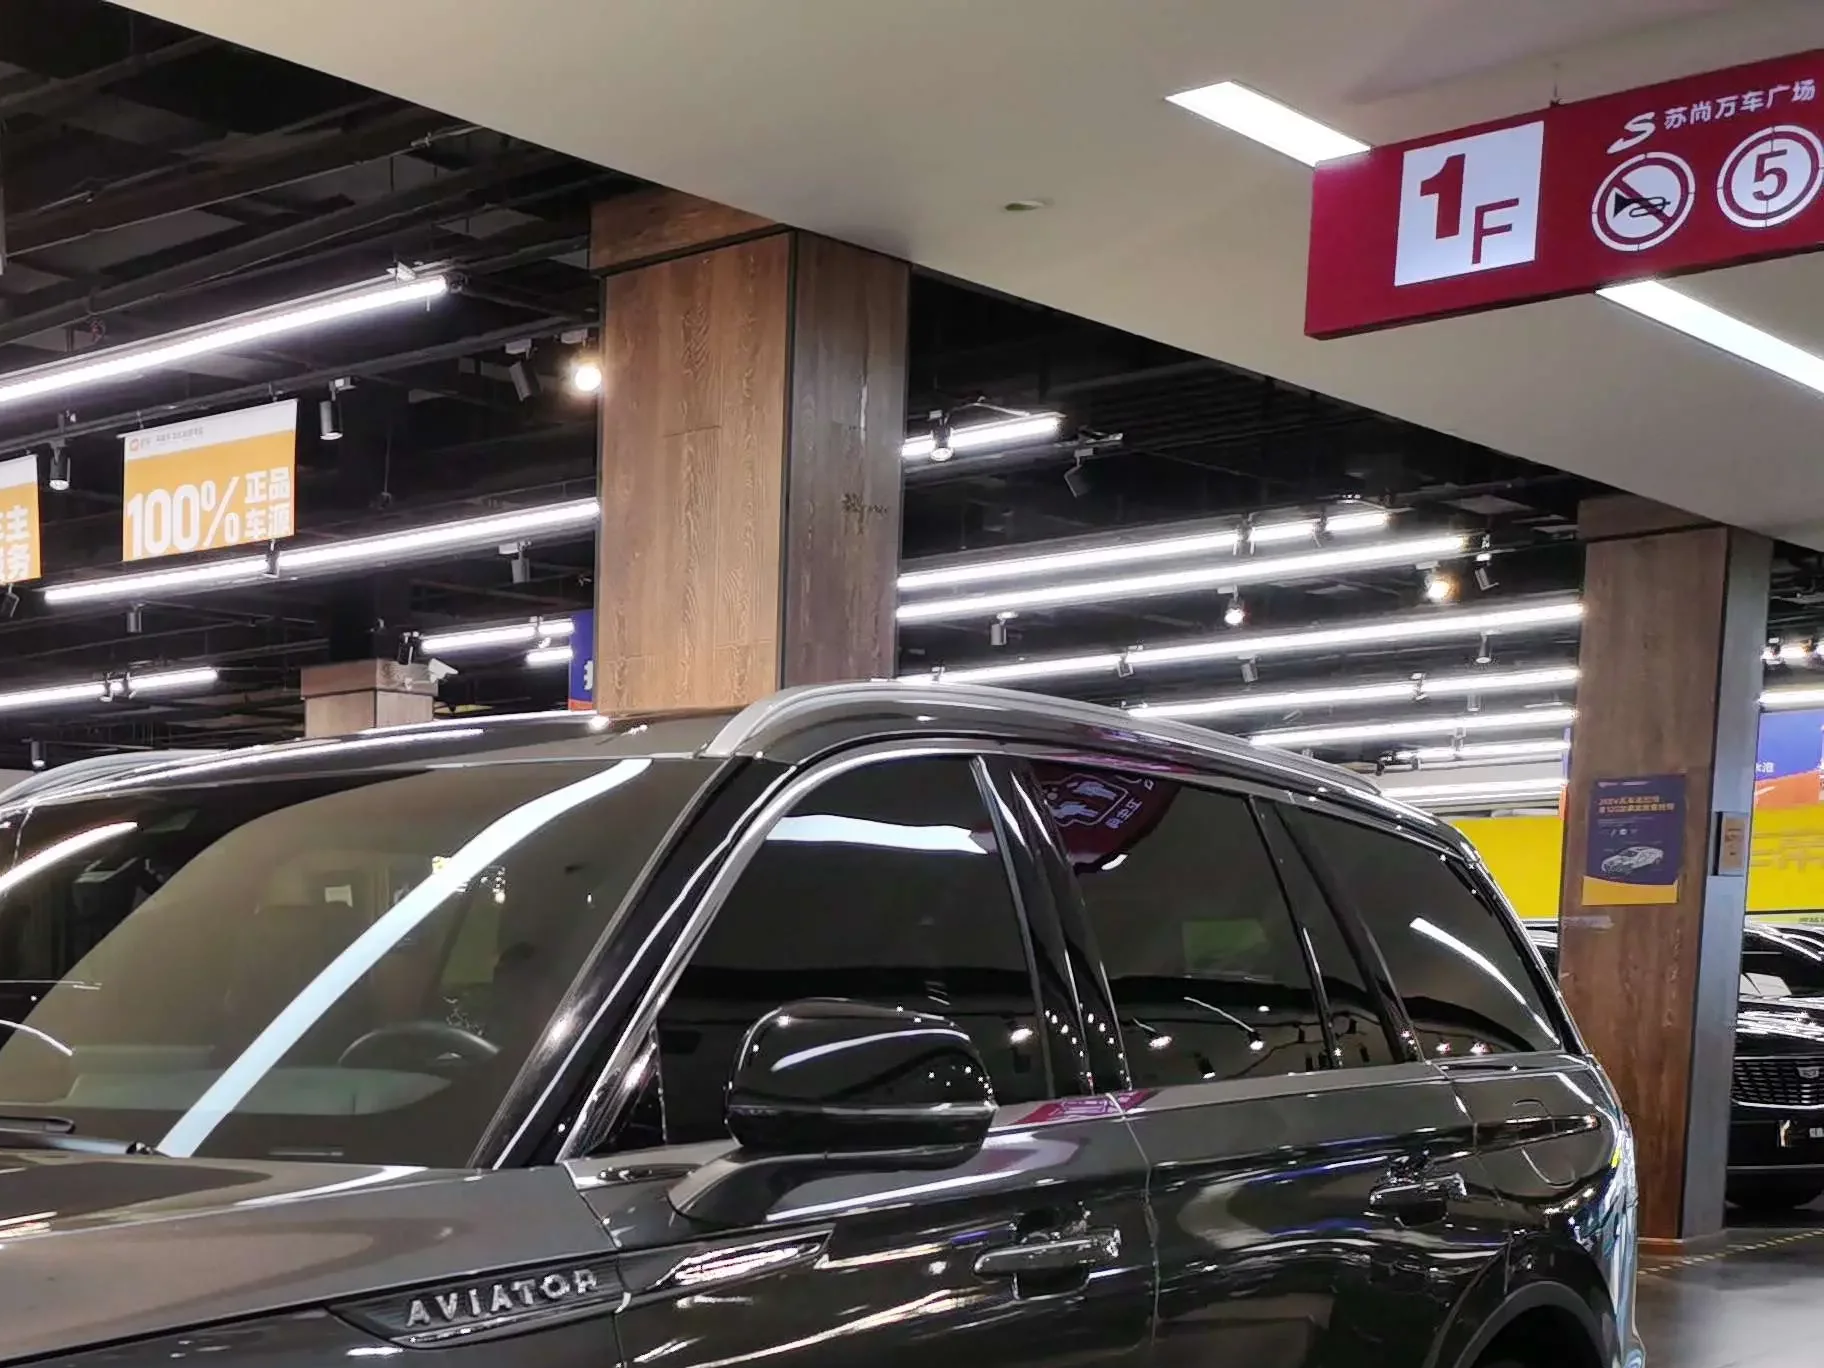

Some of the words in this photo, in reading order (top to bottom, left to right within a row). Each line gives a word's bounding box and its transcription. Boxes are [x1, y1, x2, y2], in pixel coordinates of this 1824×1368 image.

[1663, 78, 1816, 132] 苏尚万车广场
[1752, 148, 1789, 202] 5
[127, 476, 241, 560] 100%
[405, 1268, 598, 1328] AVIATOR
